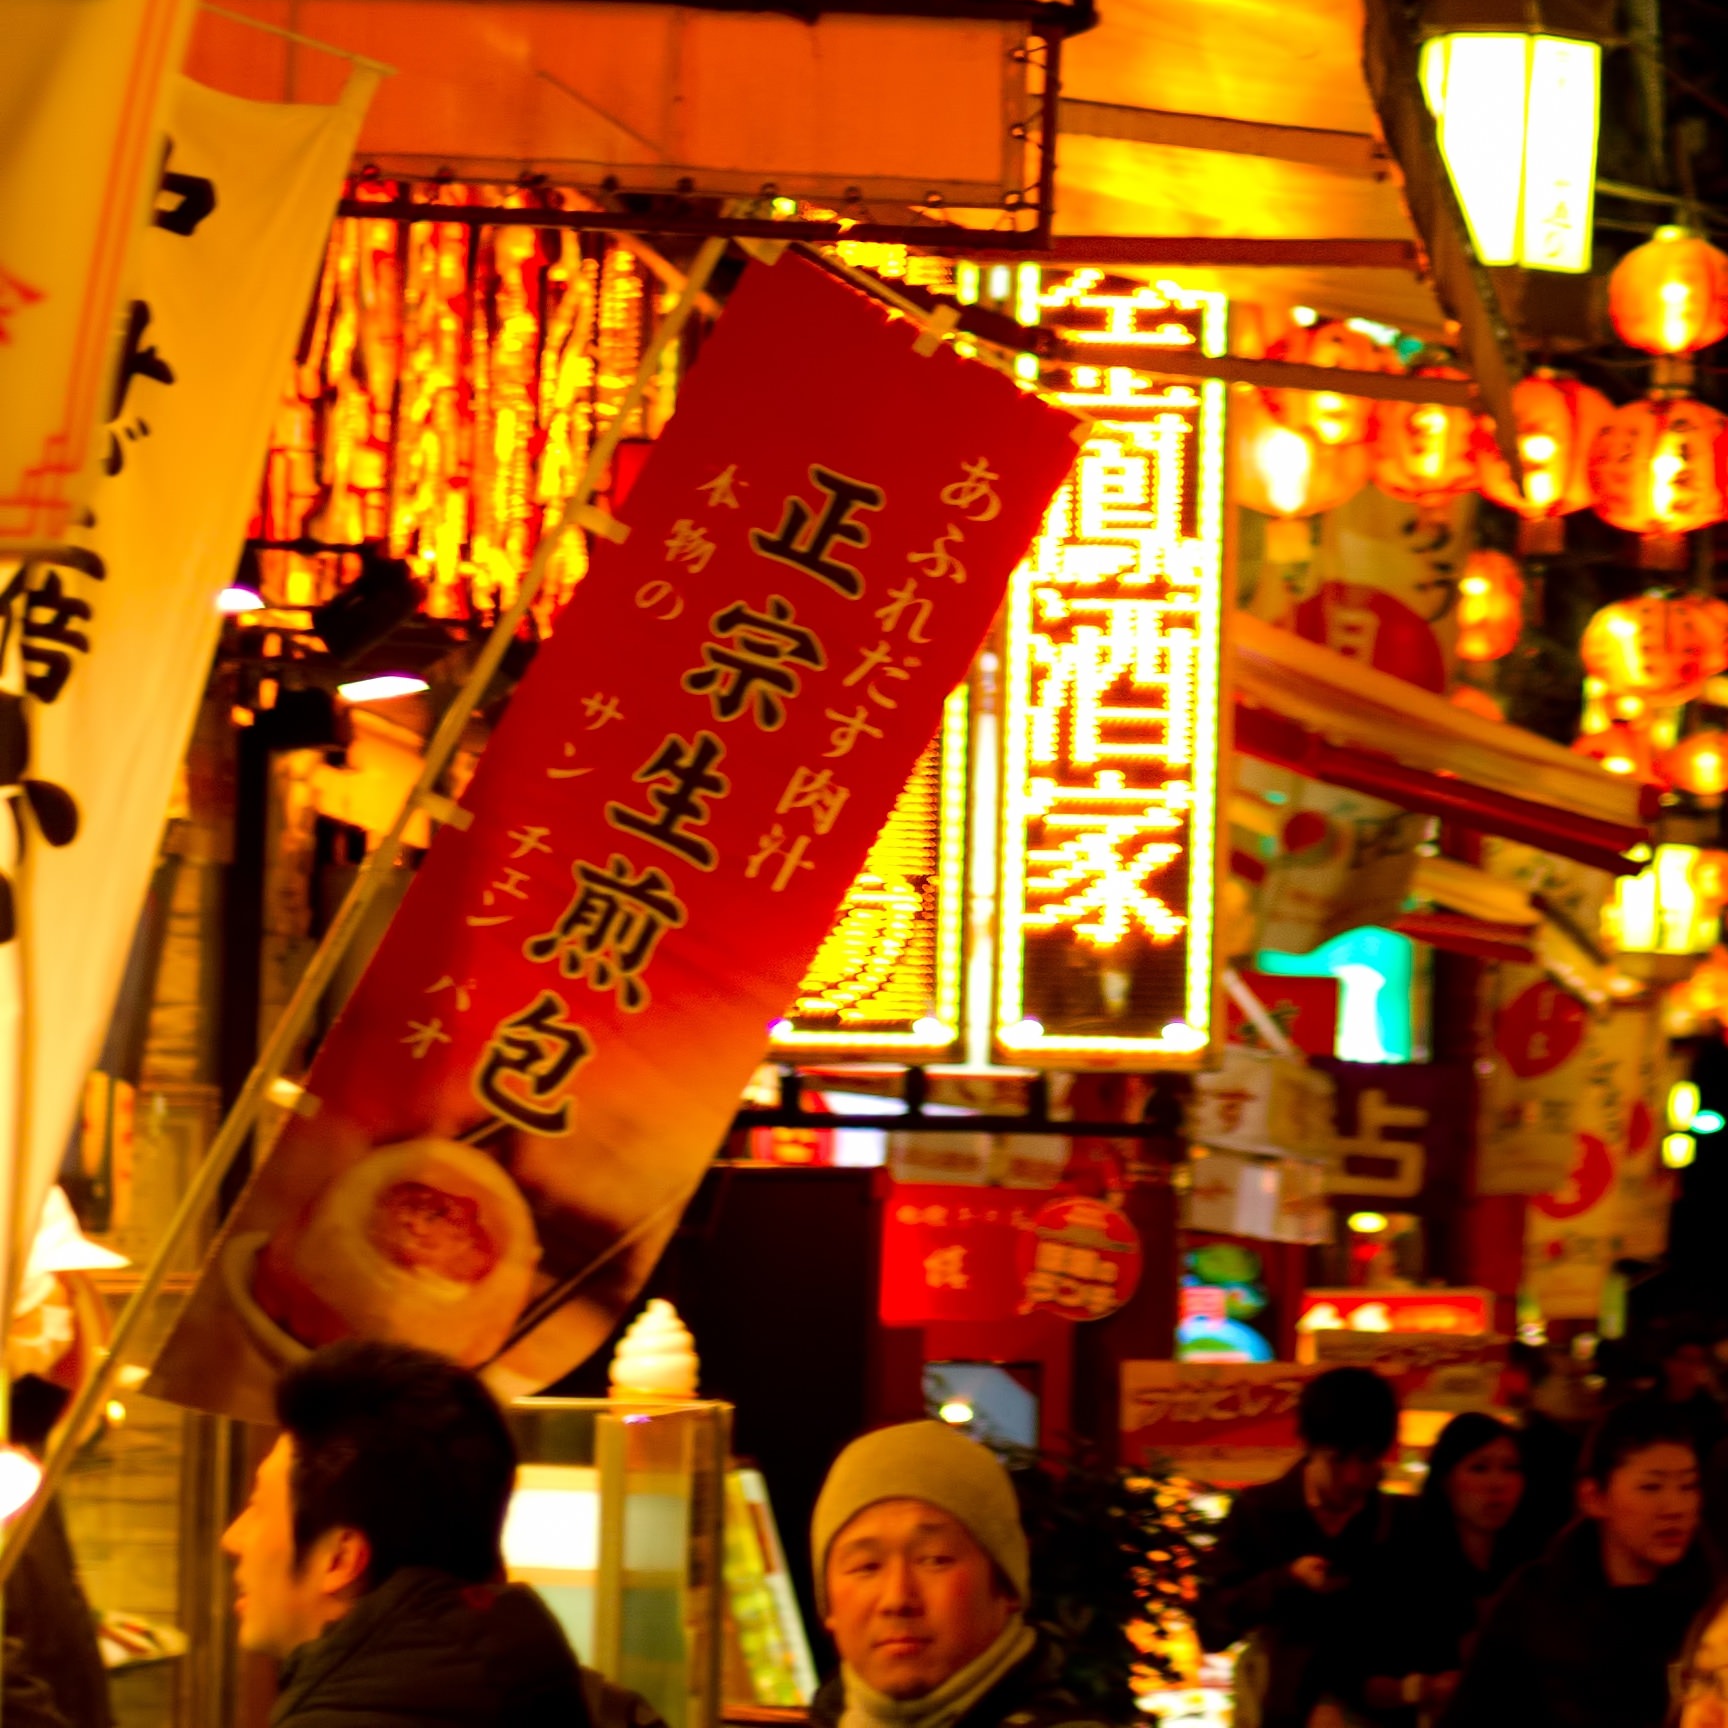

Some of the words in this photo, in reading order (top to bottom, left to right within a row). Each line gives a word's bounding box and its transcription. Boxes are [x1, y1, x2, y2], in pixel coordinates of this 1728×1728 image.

[632, 463, 751, 622] 本物の
[743, 456, 1003, 893] あふれだす肉汁
[471, 461, 887, 1136] 正宗生煎包
